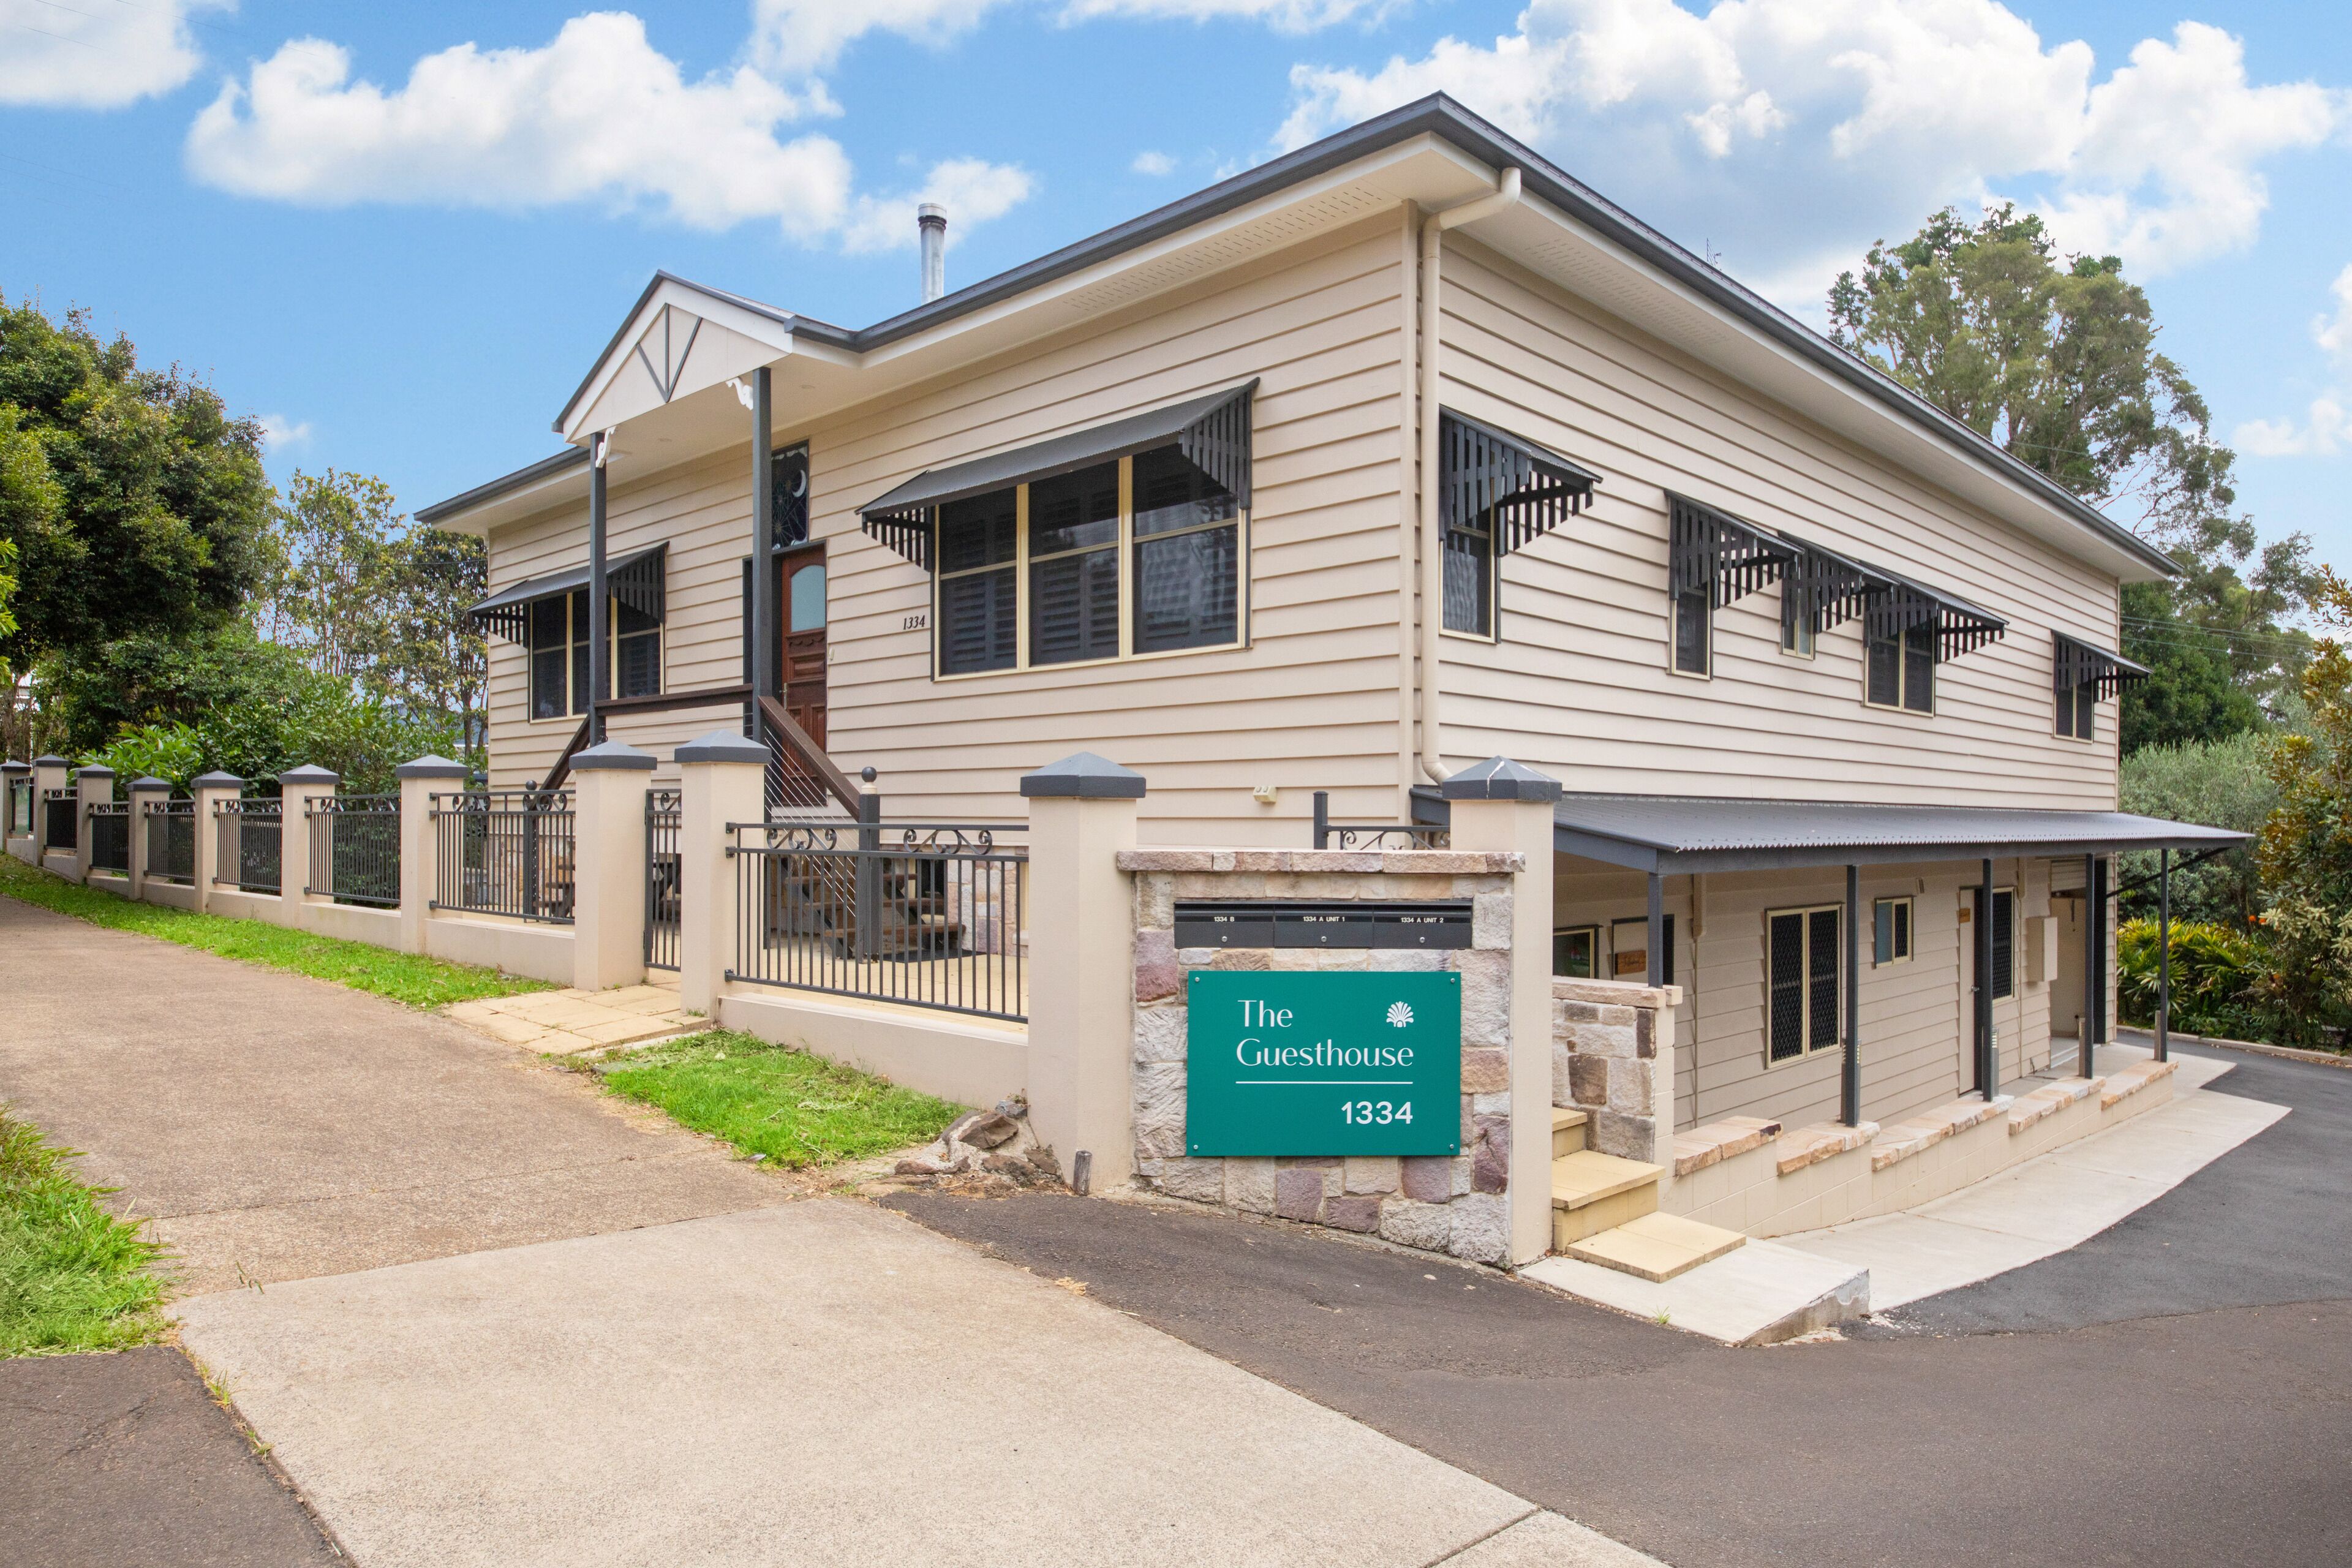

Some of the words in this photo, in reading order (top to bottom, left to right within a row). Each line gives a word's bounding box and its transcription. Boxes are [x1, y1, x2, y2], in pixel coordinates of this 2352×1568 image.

[903, 614, 925, 630] 1334
[1237, 1000, 1293, 1028] The
[1236, 1038, 1414, 1066] Guesthouse
[1341, 1101, 1413, 1125] 1334
